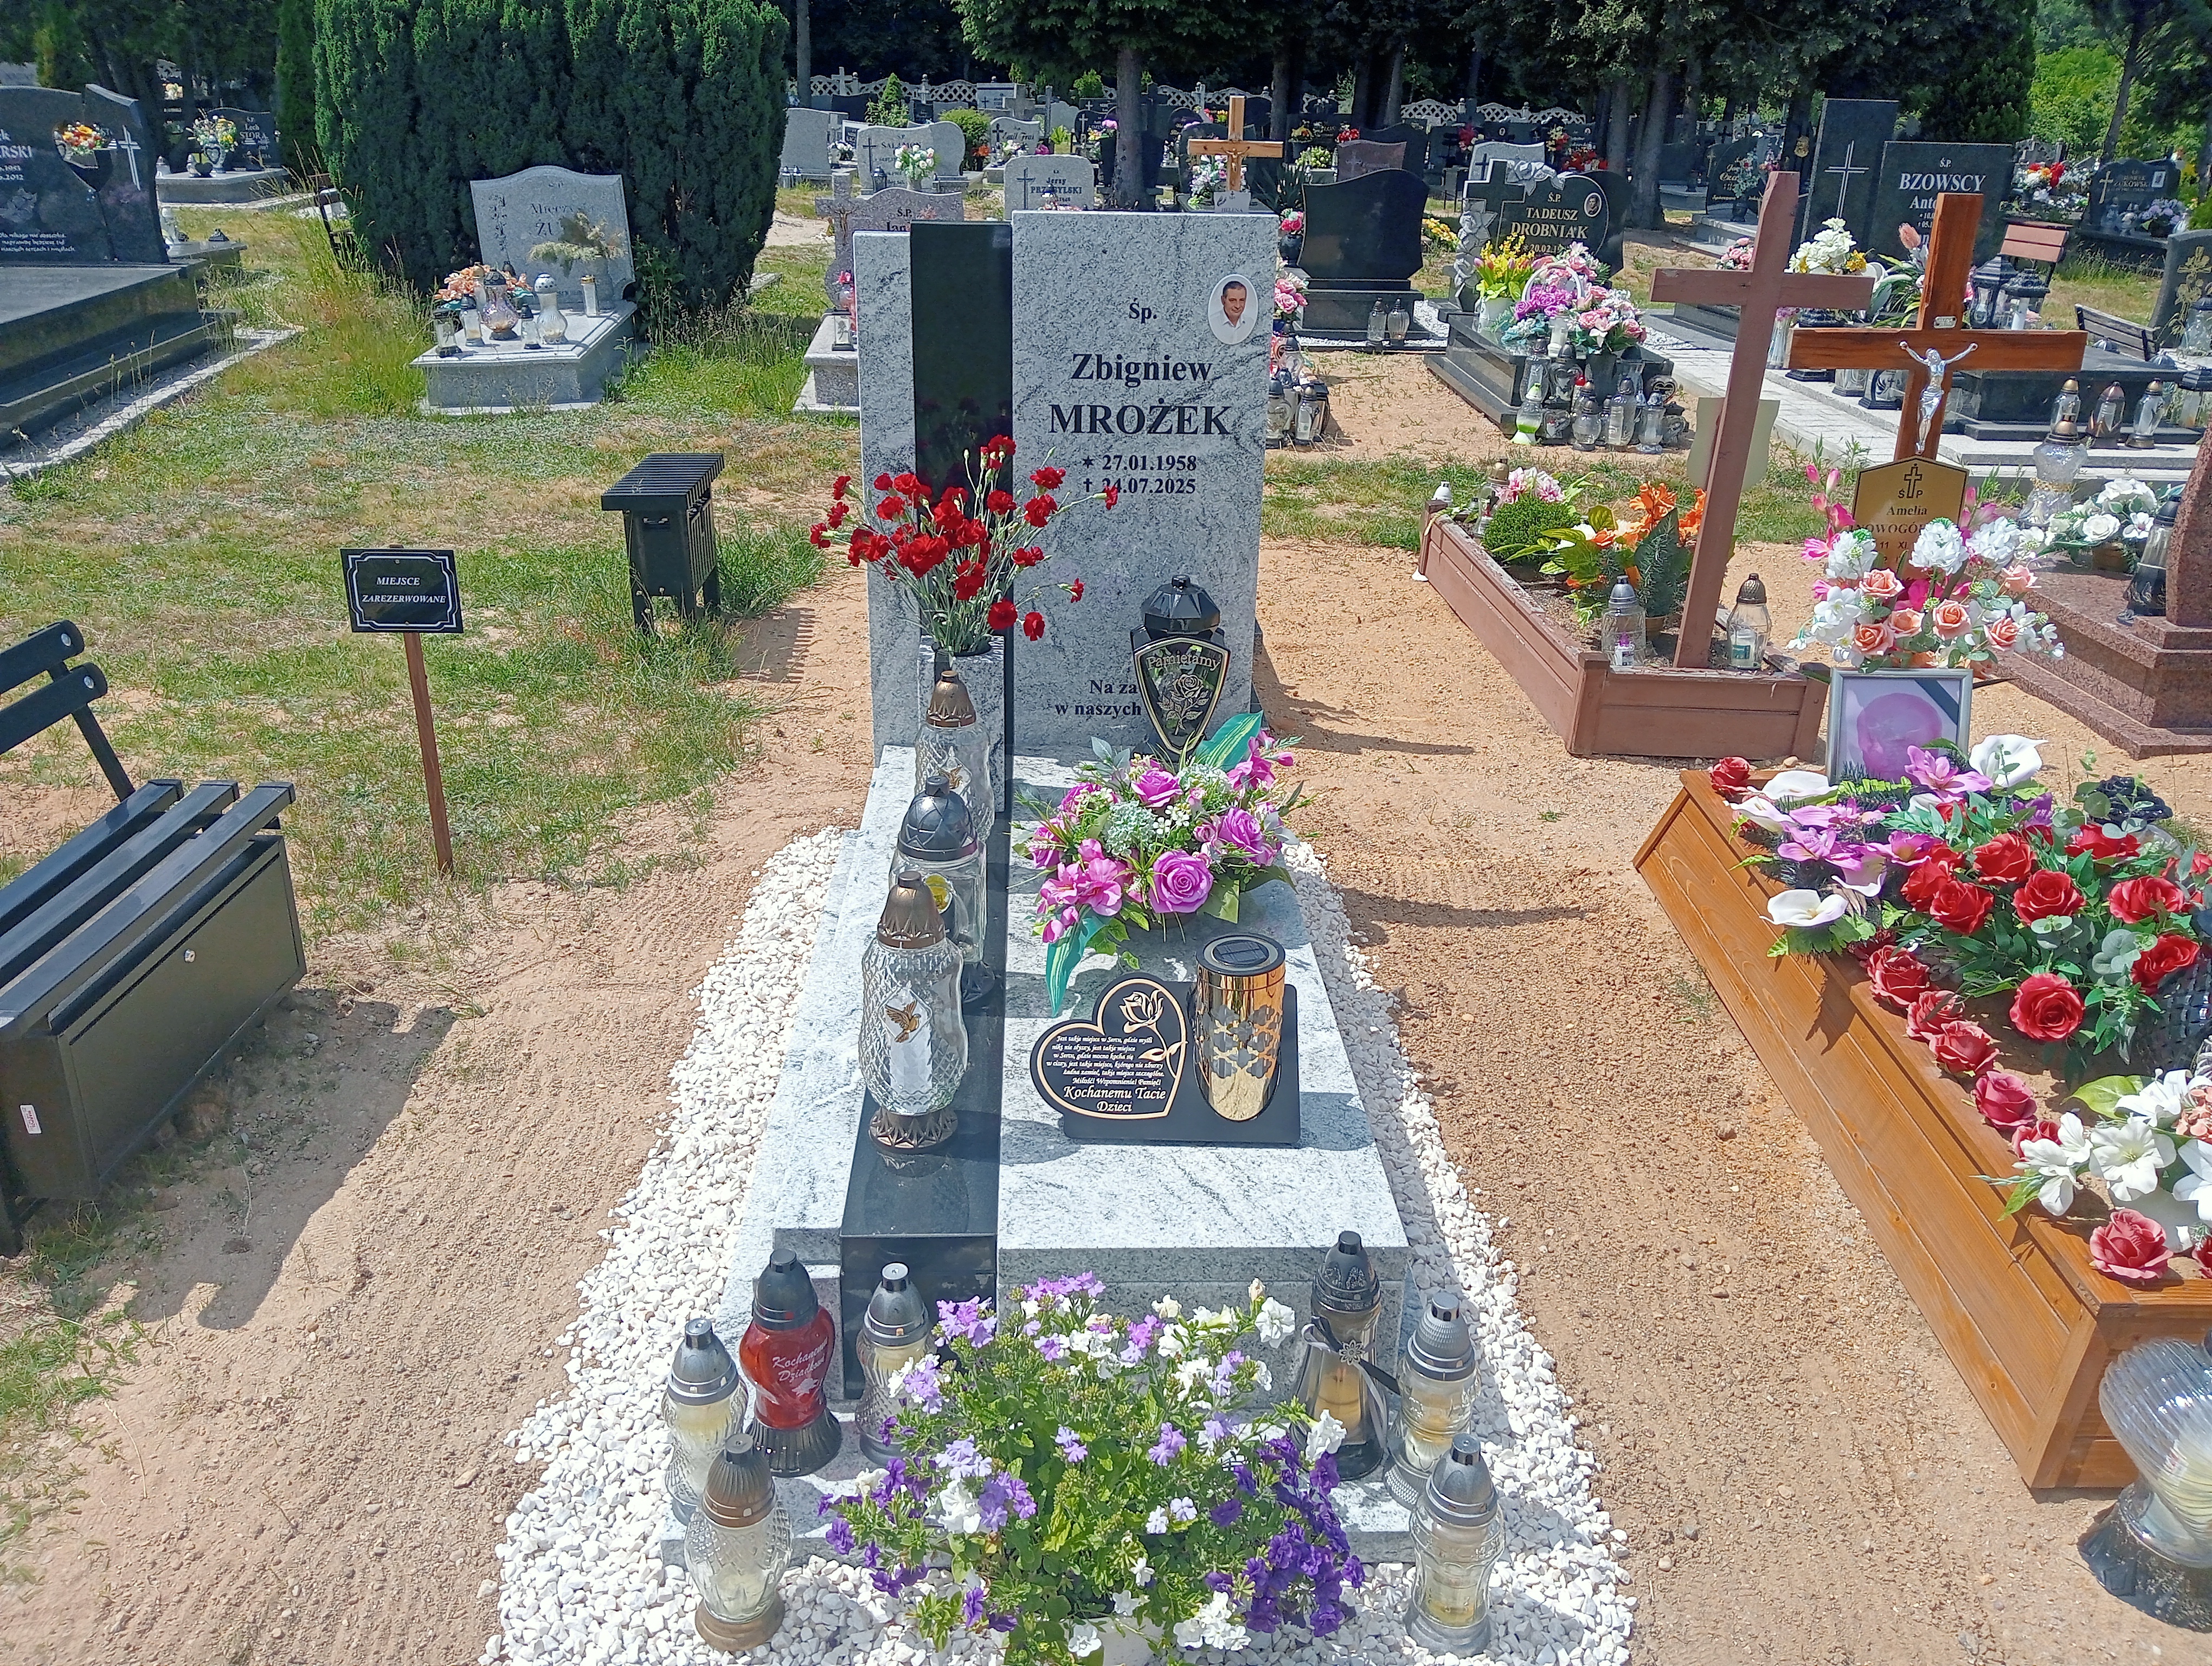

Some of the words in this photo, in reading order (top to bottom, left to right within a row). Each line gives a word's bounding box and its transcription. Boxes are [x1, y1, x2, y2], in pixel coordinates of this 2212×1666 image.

[0, 145, 33, 158] RSKI
[1899, 172, 1986, 192] BZOWSCY
[1030, 186, 1083, 194] PRZBYLSKI
[1908, 196, 1937, 209] Anto
[1526, 207, 1579, 221] TADEUSZ
[1511, 222, 1589, 239] DROBNIAK
[1129, 298, 1158, 324] Śp.
[1071, 354, 1213, 388] Zbigniew
[1049, 398, 1232, 435] MROŻEK
[1102, 454, 1197, 471] 27.01.1958
[1886, 505, 1928, 516] Amelia
[376, 577, 421, 586] MIEJSCE
[362, 594, 447, 604] ZAREZERWOWANE
[1146, 650, 1220, 671] Pamiętamy
[1090, 680, 1114, 694] Na
[1075, 702, 1141, 719] naszych
[1123, 1036, 1138, 1045] gdzie
[1114, 1061, 1134, 1069] którego
[1144, 1062, 1163, 1070] zburzy
[1116, 1069, 1134, 1078] miejsce
[1063, 1085, 1133, 1100] Kochanemu
[1135, 1087, 1166, 1100] Tacie
[1096, 1101, 1133, 1112] Dzieci
